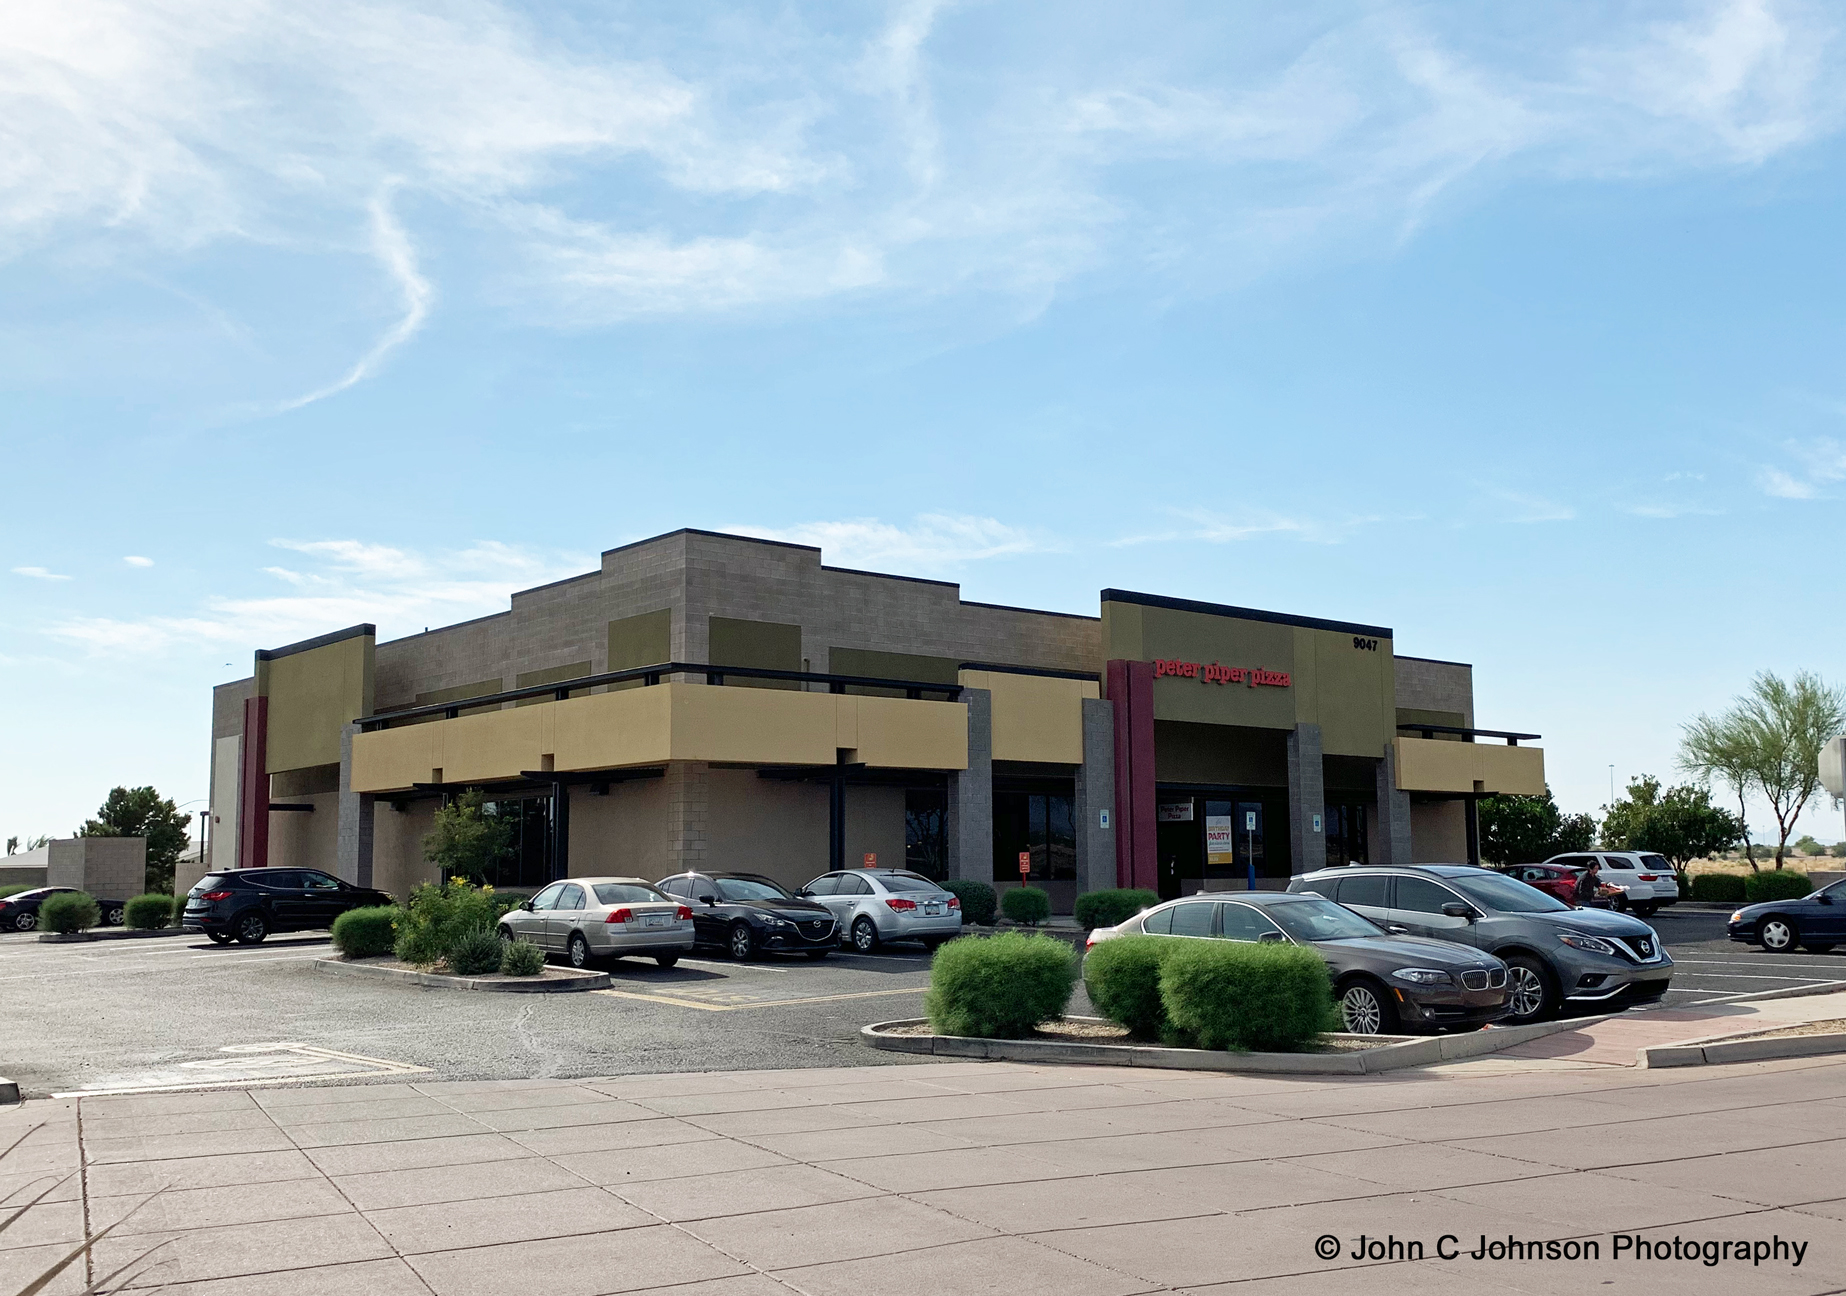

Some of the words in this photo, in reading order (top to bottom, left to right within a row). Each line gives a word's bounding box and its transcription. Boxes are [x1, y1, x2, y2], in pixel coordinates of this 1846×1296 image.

[1353, 637, 1378, 651] 9047
[1154, 658, 1201, 678] peter
[1203, 660, 1249, 684] piper
[1250, 665, 1292, 688] pizza
[1208, 832, 1230, 840] PARTY
